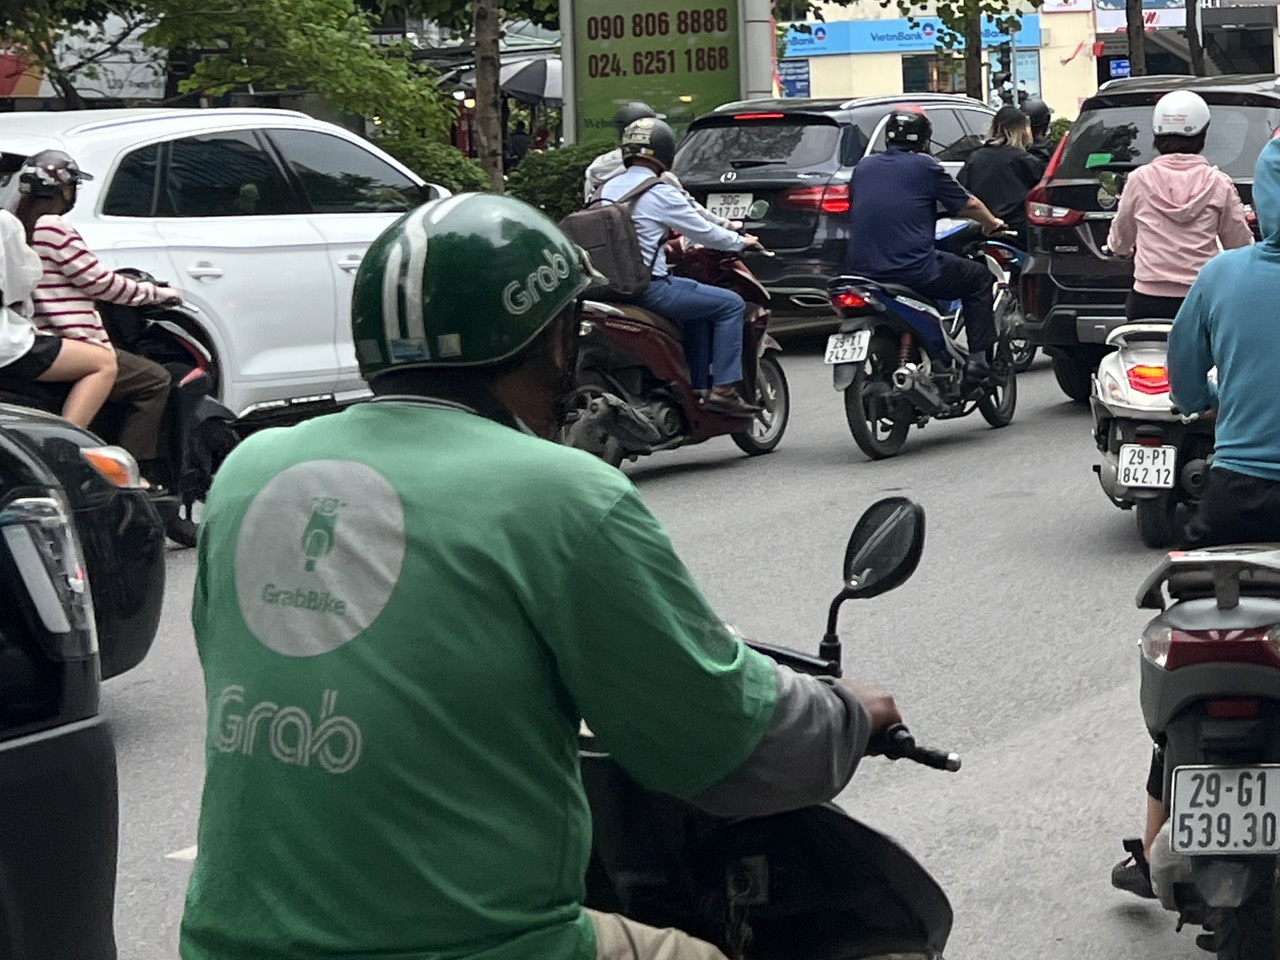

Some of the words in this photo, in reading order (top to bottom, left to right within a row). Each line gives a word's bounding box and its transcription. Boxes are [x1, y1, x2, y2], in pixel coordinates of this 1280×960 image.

[587, 15, 625, 41] 090
[632, 11, 669, 38] 806
[677, 7, 727, 35] 8888
[588, 53, 627, 78] 024.
[633, 50, 675, 76] 6251
[684, 46, 729, 73] 1868
[720, 194, 739, 206] 30G
[503, 249, 569, 314] Grab
[1129, 449, 1167, 466] 29-P1
[1123, 467, 1171, 485] 842.12
[261, 584, 346, 616] GrabBike
[215, 684, 363, 775] Grab
[1189, 771, 1267, 808] 29-G1
[1178, 812, 1277, 849] 539.30
